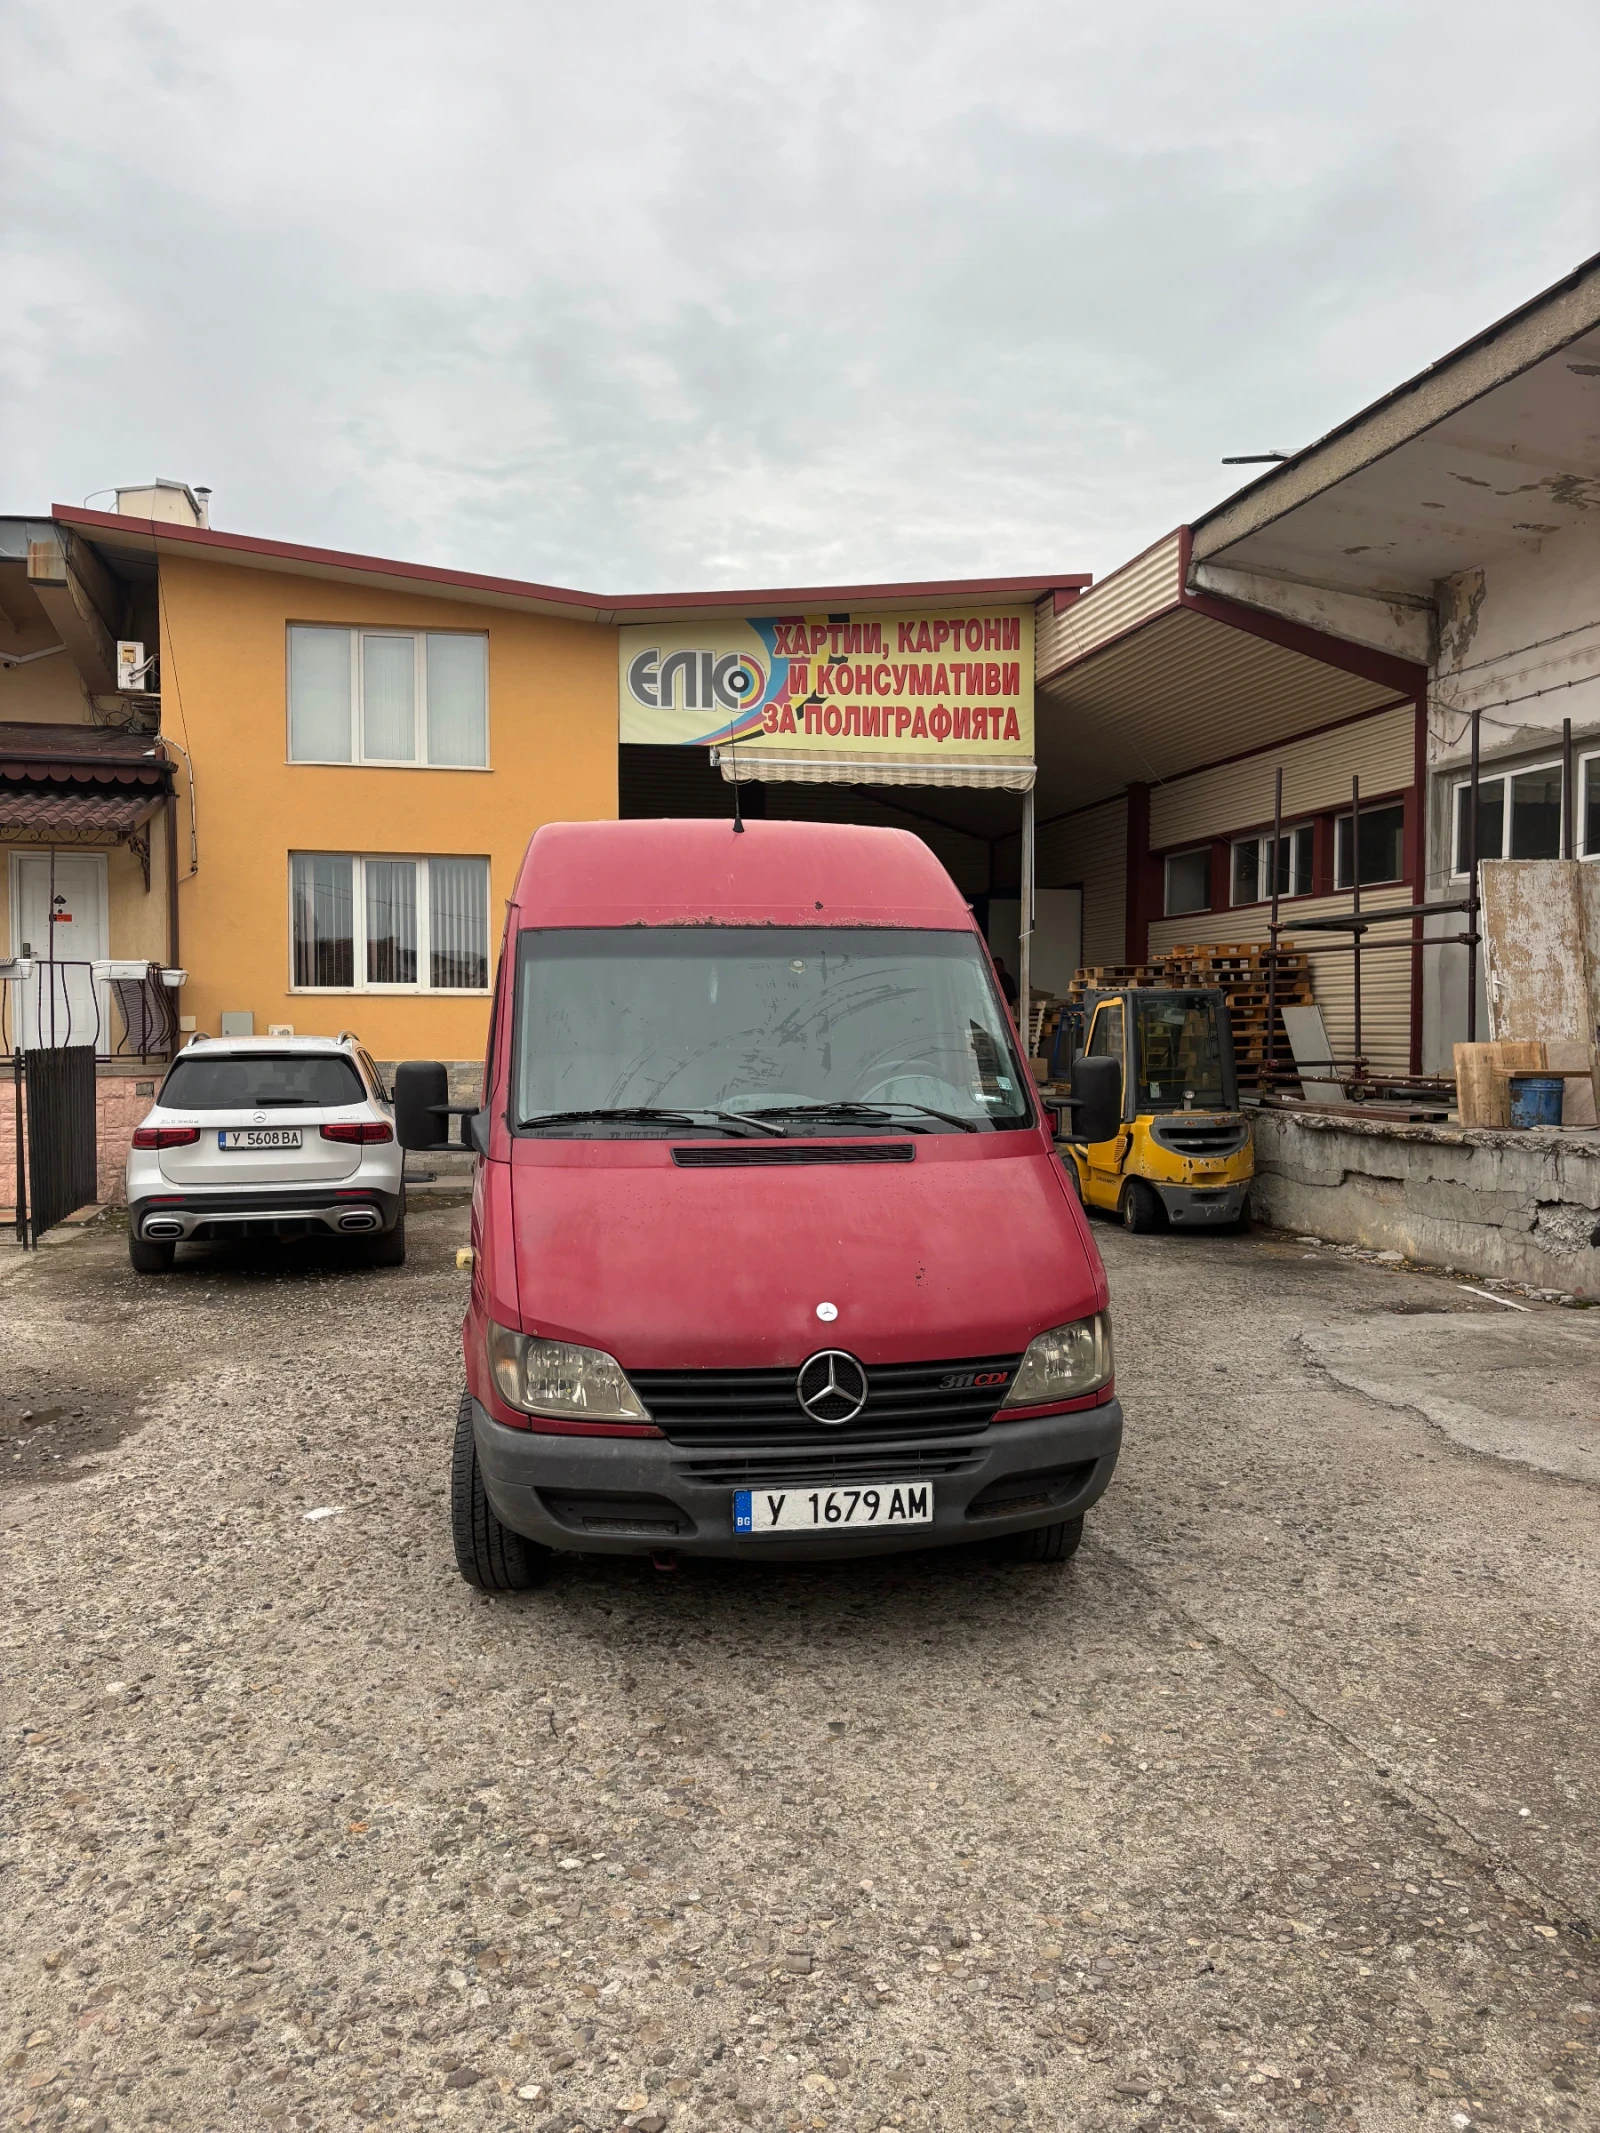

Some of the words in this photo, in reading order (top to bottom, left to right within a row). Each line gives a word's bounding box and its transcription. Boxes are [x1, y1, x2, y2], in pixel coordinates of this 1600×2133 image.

[773, 623, 889, 660] ХАРТИИ,
[898, 617, 1020, 653] КАРТОНИ
[789, 664, 808, 695] И
[817, 662, 1020, 696] КОНСУМАТИВИ
[763, 703, 797, 734] ЗА
[804, 703, 1021, 742] ПОЛИГРАФИЯТА
[247, 1132, 280, 1145] 5608
[737, 1517, 750, 1526] BG
[808, 1490, 880, 1524] 1679
